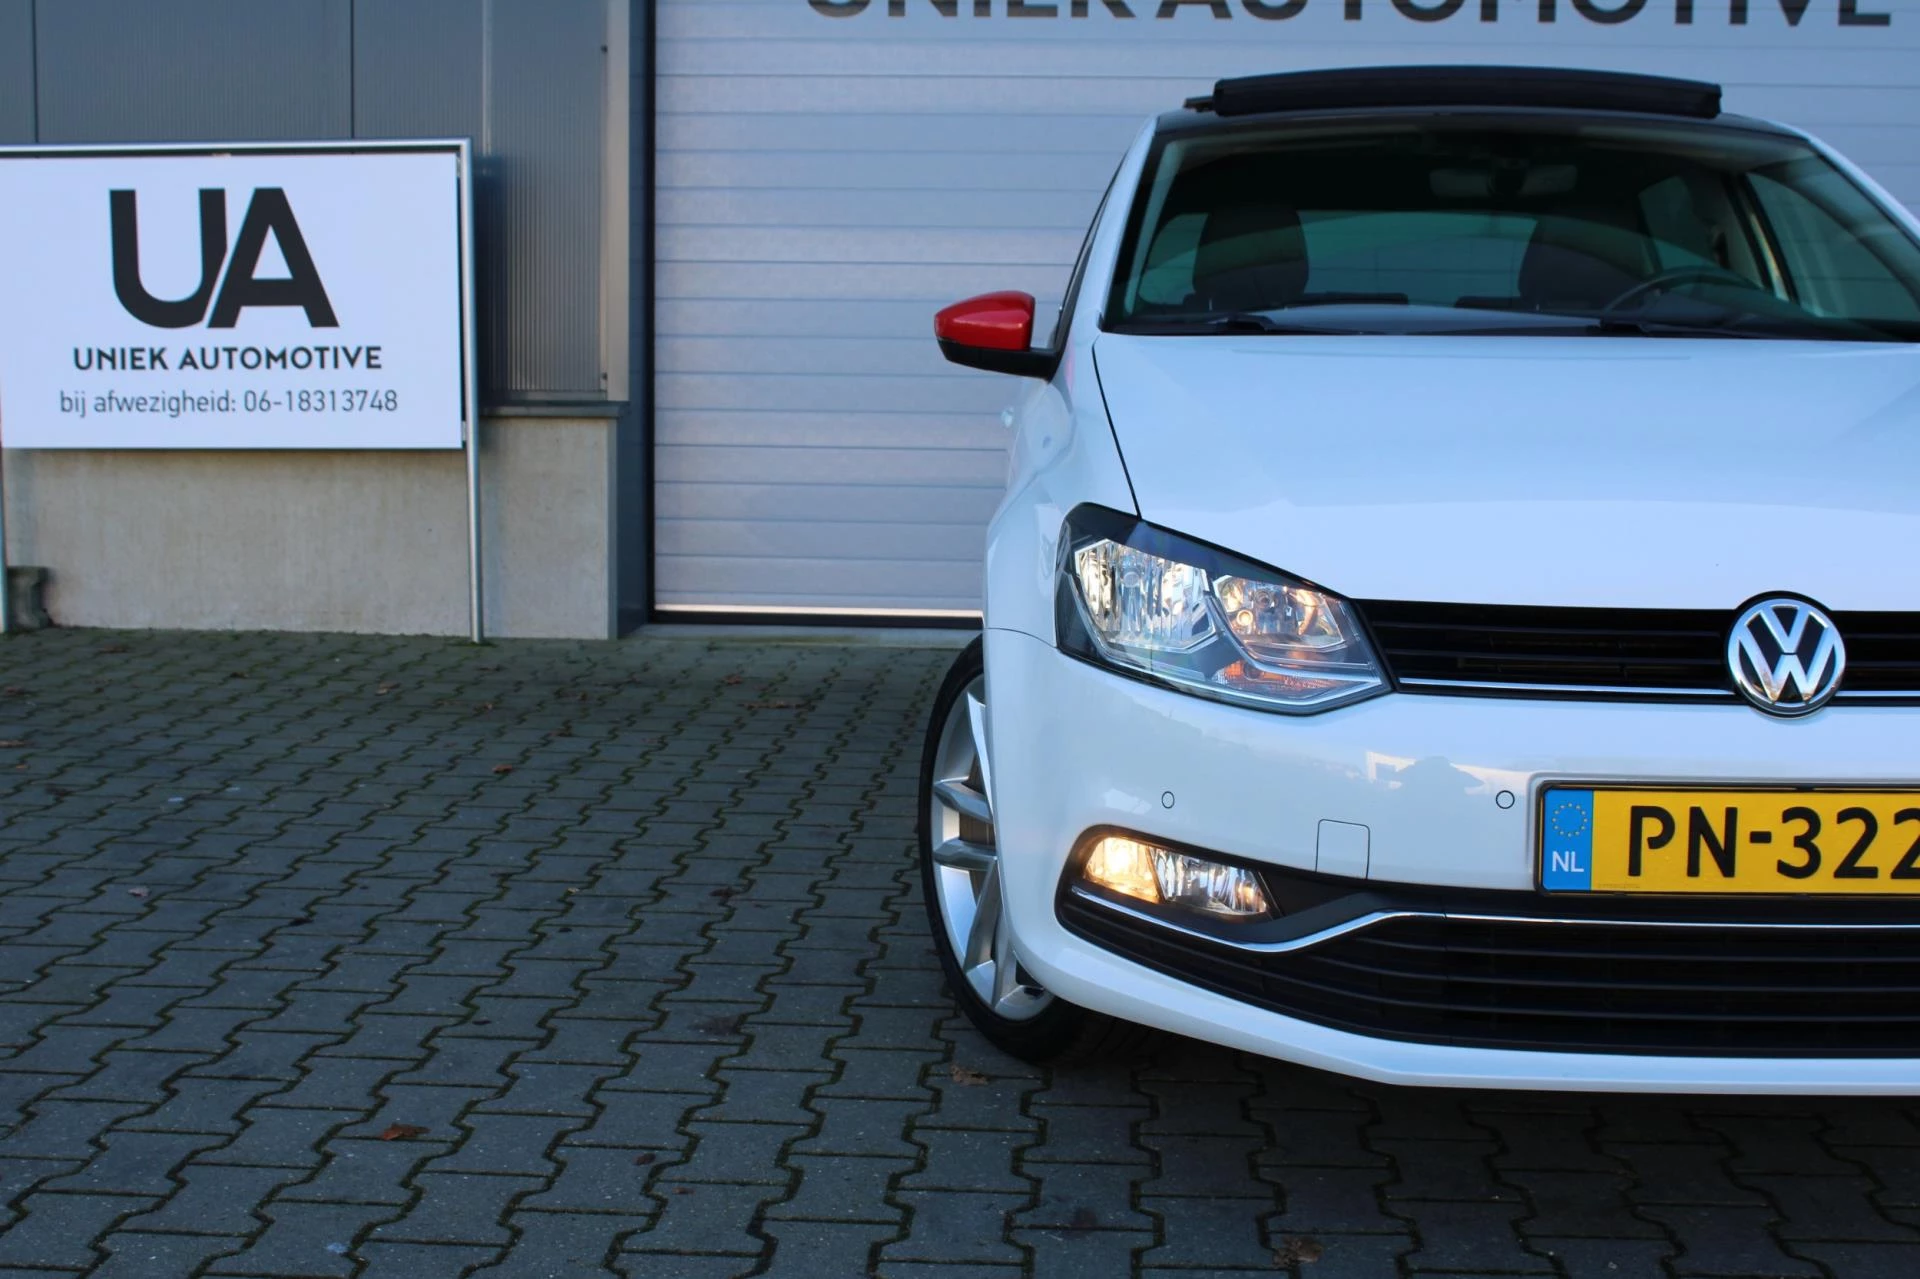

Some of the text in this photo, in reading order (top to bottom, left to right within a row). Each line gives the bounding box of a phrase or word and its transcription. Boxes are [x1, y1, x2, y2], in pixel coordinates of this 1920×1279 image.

[109, 187, 340, 329] UA
[73, 345, 382, 371] UNIEK AUTOMOTIVE
[60, 389, 398, 419] bij afwezigheid: 06-18313748
[1551, 851, 1585, 873] NL
